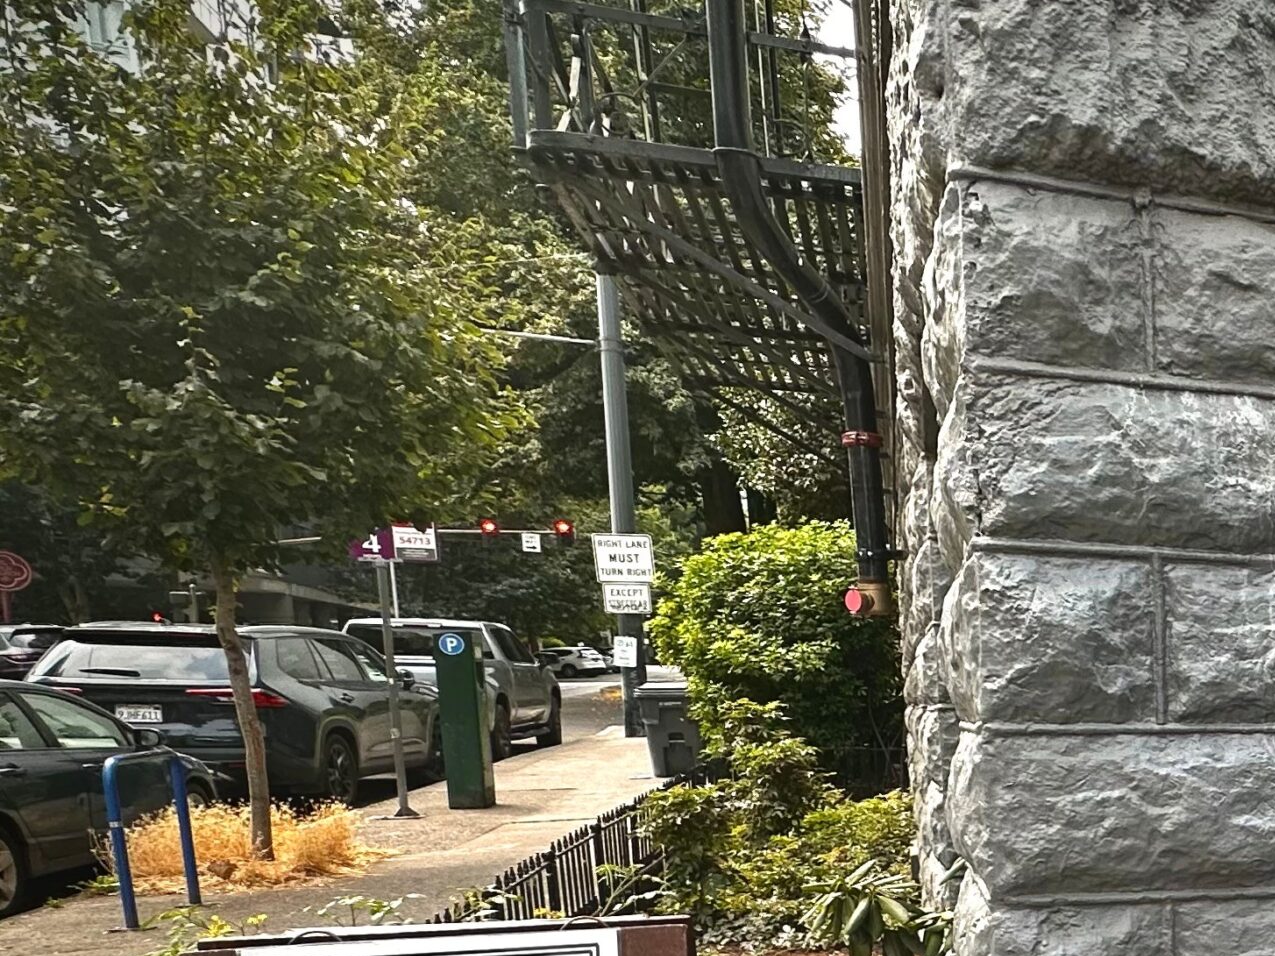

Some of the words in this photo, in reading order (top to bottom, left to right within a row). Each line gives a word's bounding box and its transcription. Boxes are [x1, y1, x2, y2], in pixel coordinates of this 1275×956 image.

[362, 534, 382, 553] 4
[399, 536, 431, 546] 54713
[597, 540, 622, 548] RIGHT
[626, 540, 648, 549] LANE
[609, 553, 640, 563] MUST
[600, 568, 624, 576] TURN
[626, 568, 652, 576] RIGHT
[610, 588, 643, 597] EXCEPT
[446, 637, 458, 652] P
